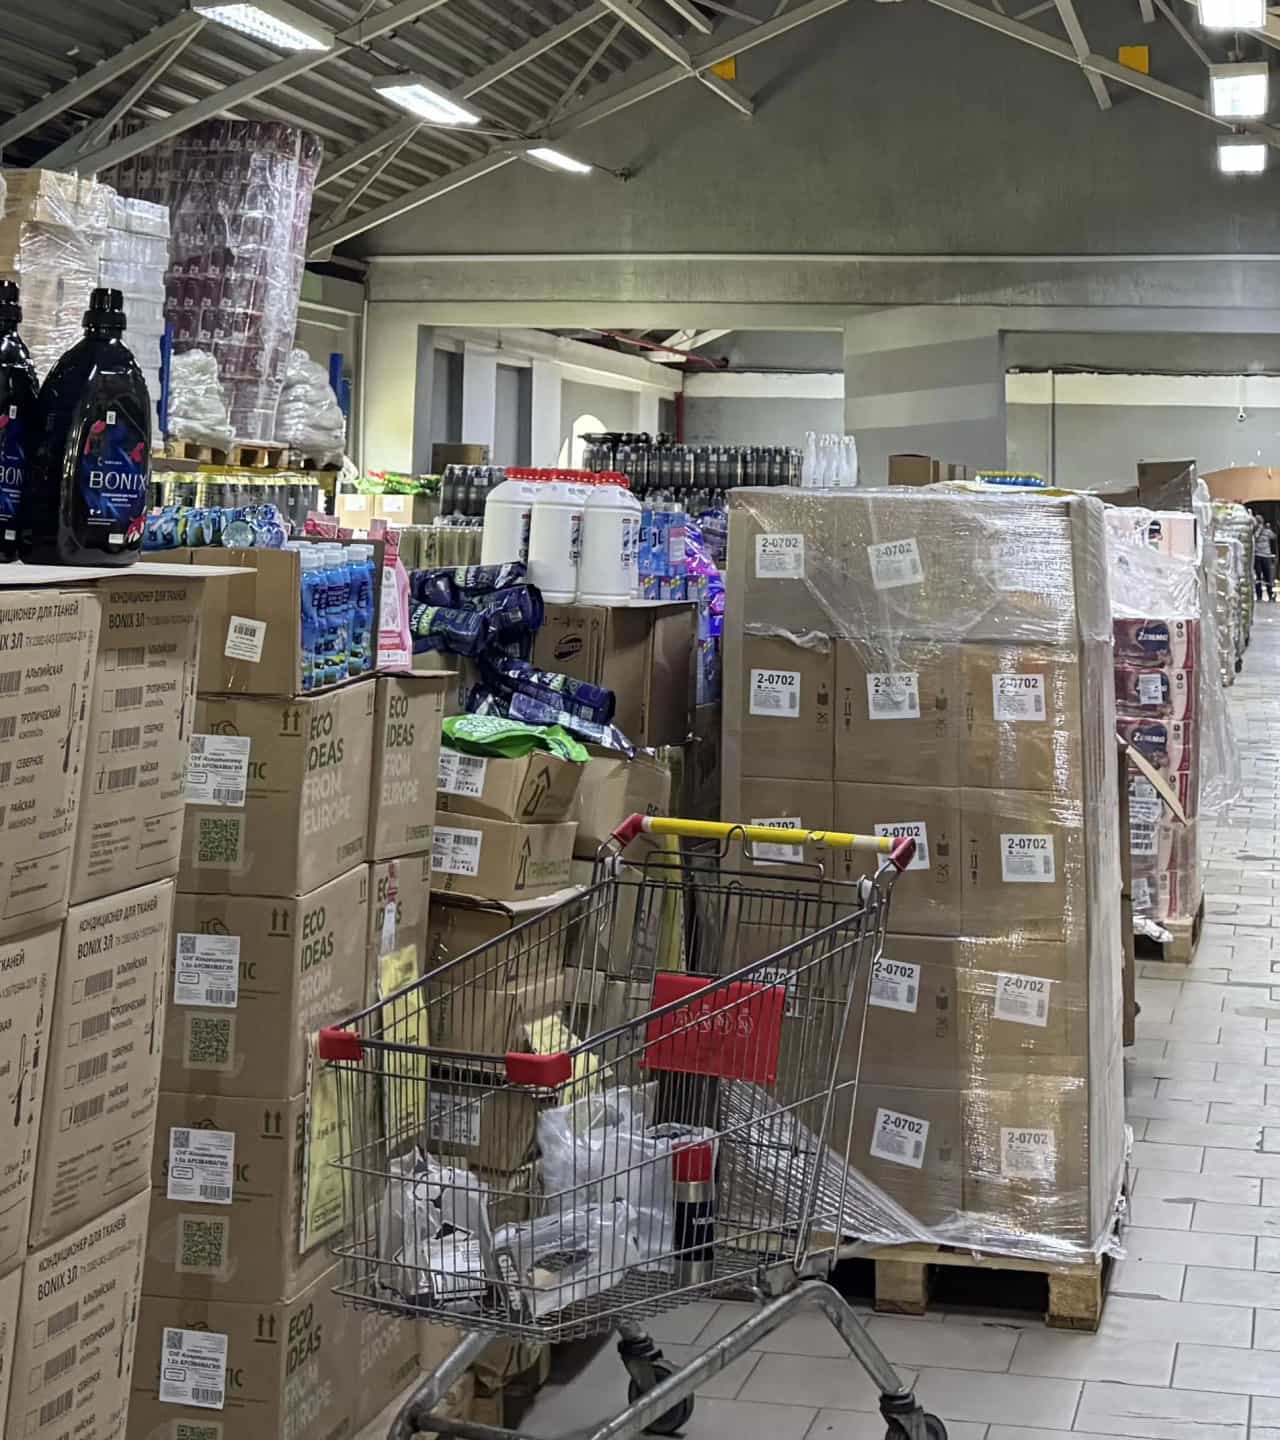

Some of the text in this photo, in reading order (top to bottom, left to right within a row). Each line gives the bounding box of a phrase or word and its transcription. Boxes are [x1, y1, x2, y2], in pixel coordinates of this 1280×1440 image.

[89, 471, 148, 491] BONIX
[760, 536, 801, 549] 2-0702
[874, 542, 914, 559] 2-0702
[37, 605, 52, 620] ДЛЯ
[52, 600, 79, 617] ТКАНЕЙ
[108, 614, 135, 630] BONIX
[10, 632, 24, 649] 3Л
[25, 664, 64, 679] АЛЬПИЙСКАЯ
[756, 673, 795, 687] 2-0702
[873, 676, 913, 689] 2-02
[998, 677, 1040, 690] 2-0702
[21, 706, 62, 724] ТРОПИЧЕСКИЙ
[389, 695, 409, 718] ECO
[309, 711, 333, 741] ECO
[385, 723, 415, 748] IDEAS
[302, 771, 343, 803] FROM
[881, 825, 922, 839] 2-0702
[1007, 837, 1048, 851] 2-0702
[79, 896, 159, 933] КОНДИЦИОНЕР ДЛЯ ТКАНЕЙ
[302, 907, 327, 939] ECO
[77, 938, 103, 960] BONIX
[300, 932, 335, 973] IDEAS
[873, 962, 916, 979] 2-0702
[1003, 975, 1046, 993] 2-0702
[882, 1113, 925, 1136] 2-0702
[1006, 1131, 1050, 1146] 2-0702
[38, 1238, 89, 1273] КОНДИЦИОНЕР
[100, 1215, 127, 1241] ТКАНЕЙ
[37, 1264, 79, 1301] BONIX 3Л
[288, 1302, 315, 1344] ECO
[286, 1323, 322, 1377] IDEAS
